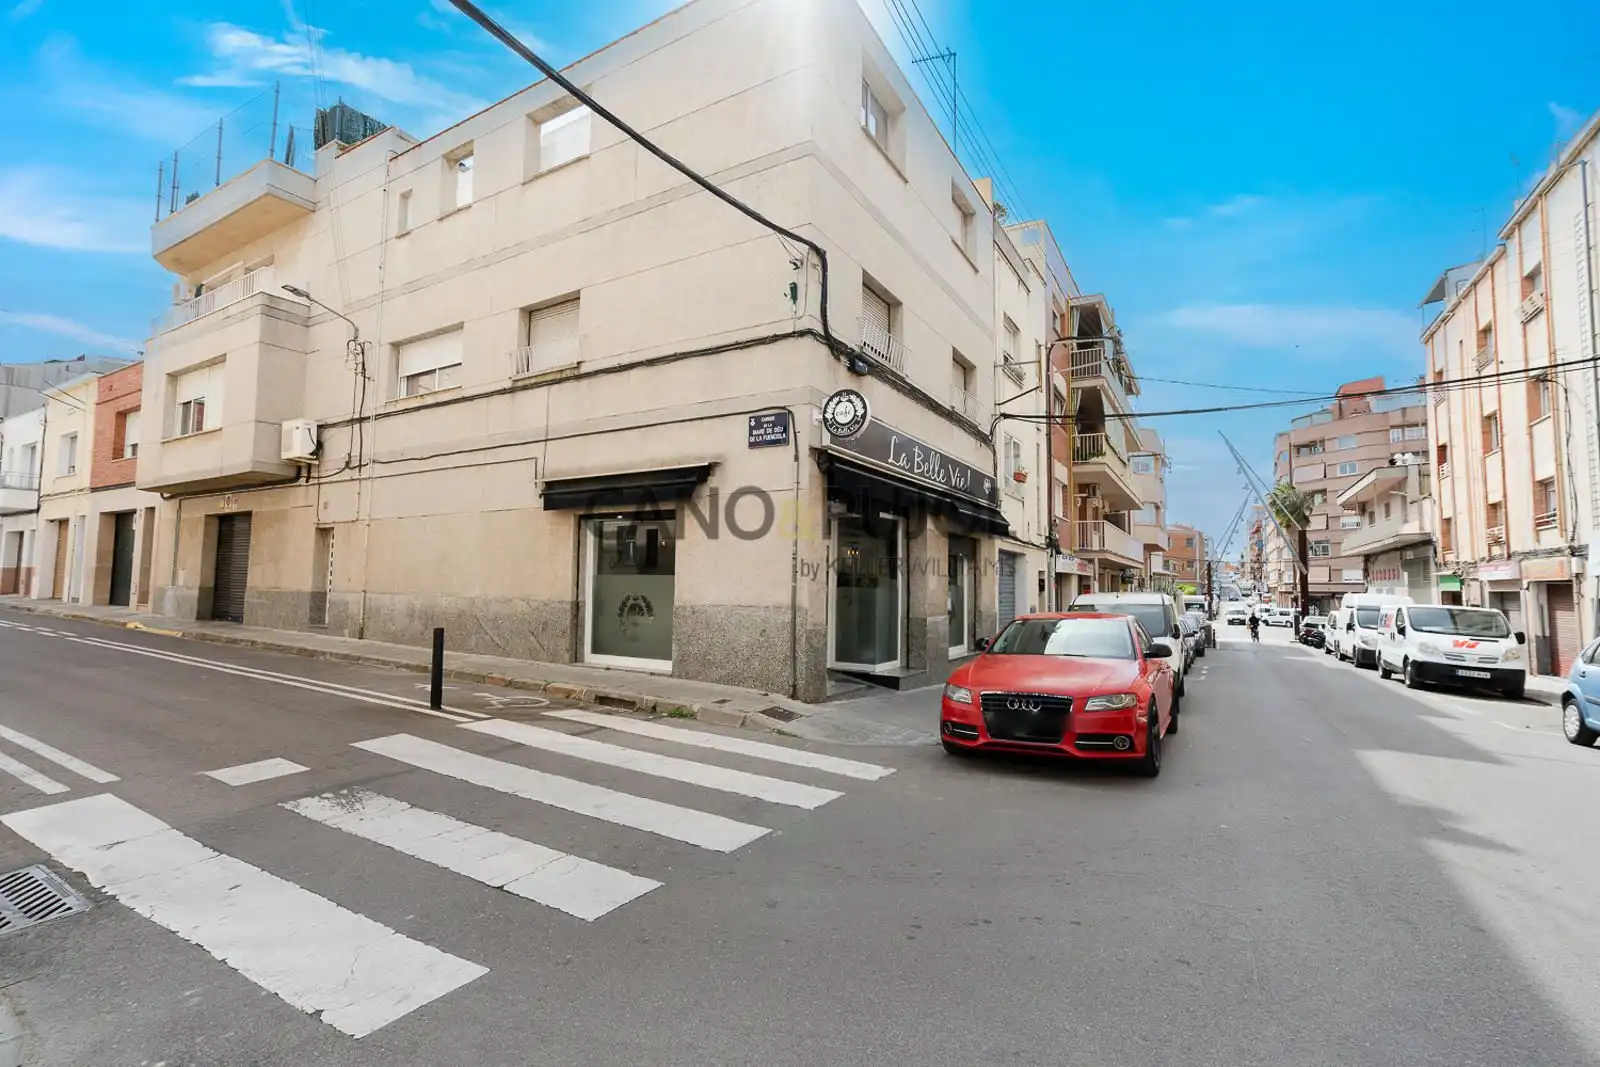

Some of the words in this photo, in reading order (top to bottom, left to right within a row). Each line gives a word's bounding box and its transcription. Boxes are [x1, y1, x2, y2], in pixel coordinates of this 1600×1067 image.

[888, 435, 911, 469] La
[912, 445, 947, 483] Belle
[948, 464, 971, 492] Vie!
